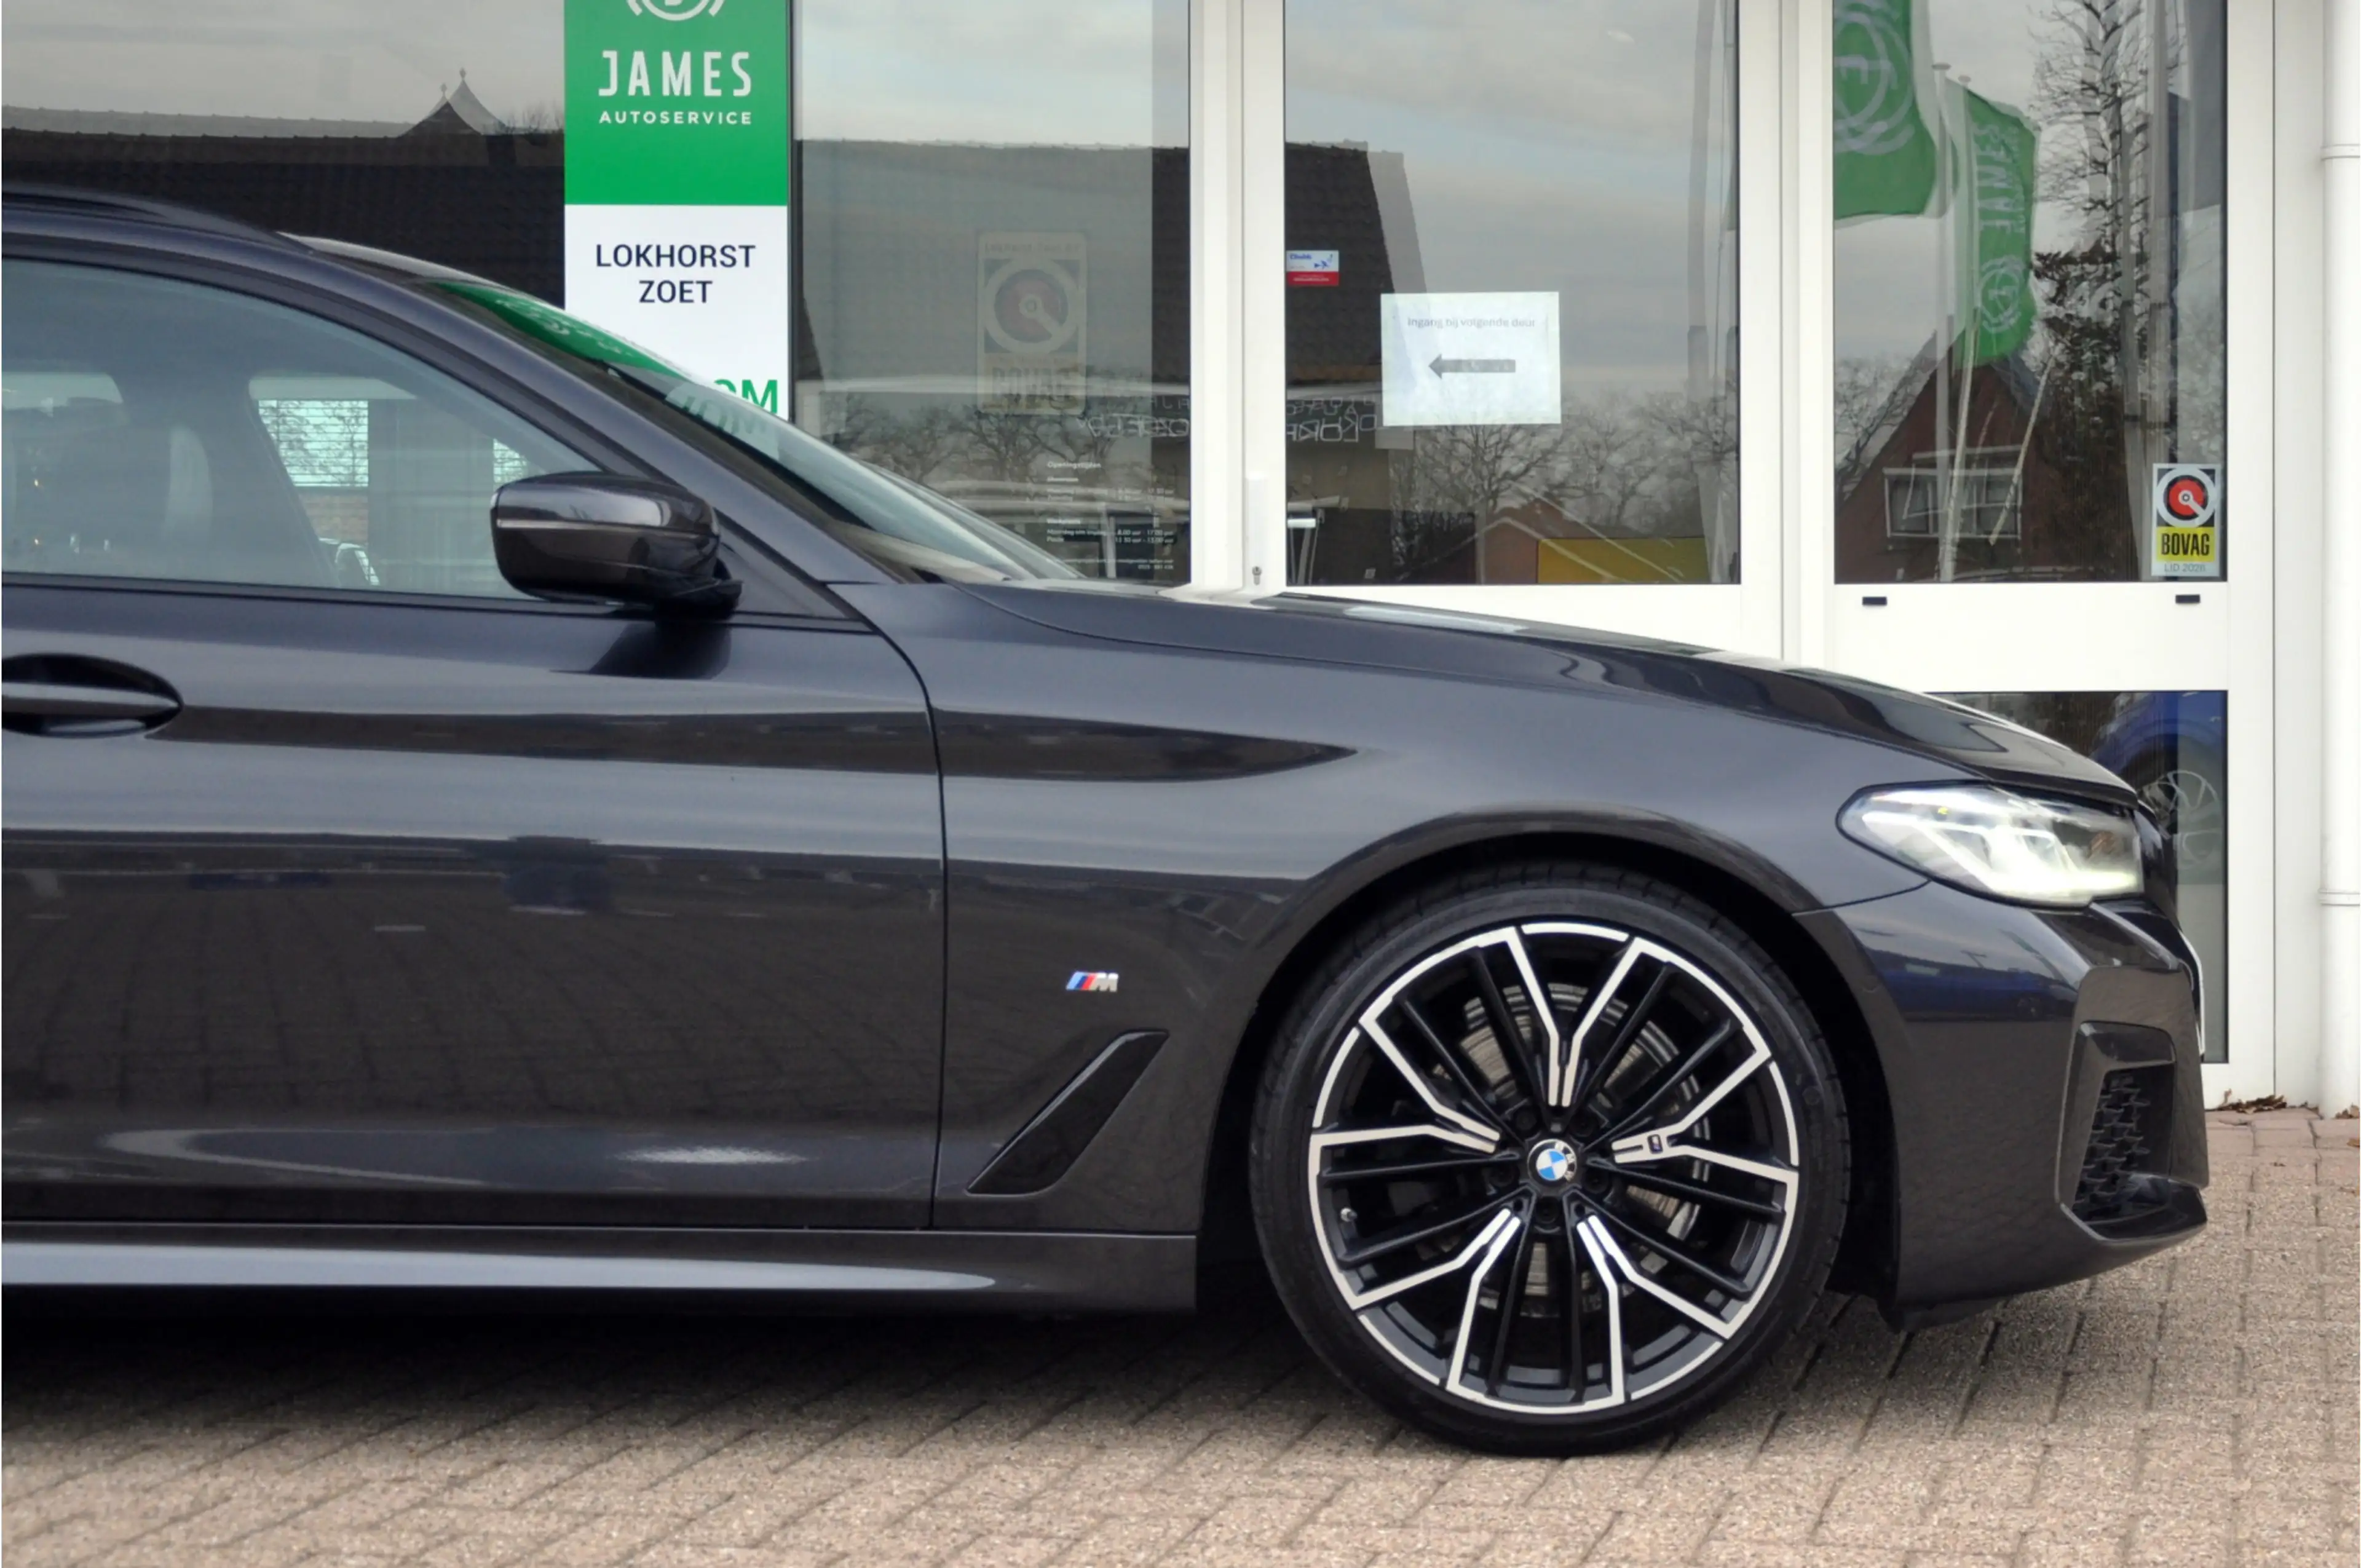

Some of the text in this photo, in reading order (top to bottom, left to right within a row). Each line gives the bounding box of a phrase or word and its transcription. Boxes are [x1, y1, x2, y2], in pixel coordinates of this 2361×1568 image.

[598, 50, 752, 97] JAMES
[599, 111, 753, 125] AUTOSERVICE
[596, 244, 756, 268] LOKHORST
[639, 280, 713, 303] ZOET
[1407, 317, 1443, 329] Ingang
[1461, 317, 1509, 328] volgende
[2162, 533, 2210, 556] BOVAG
[2164, 563, 2180, 572] LID
